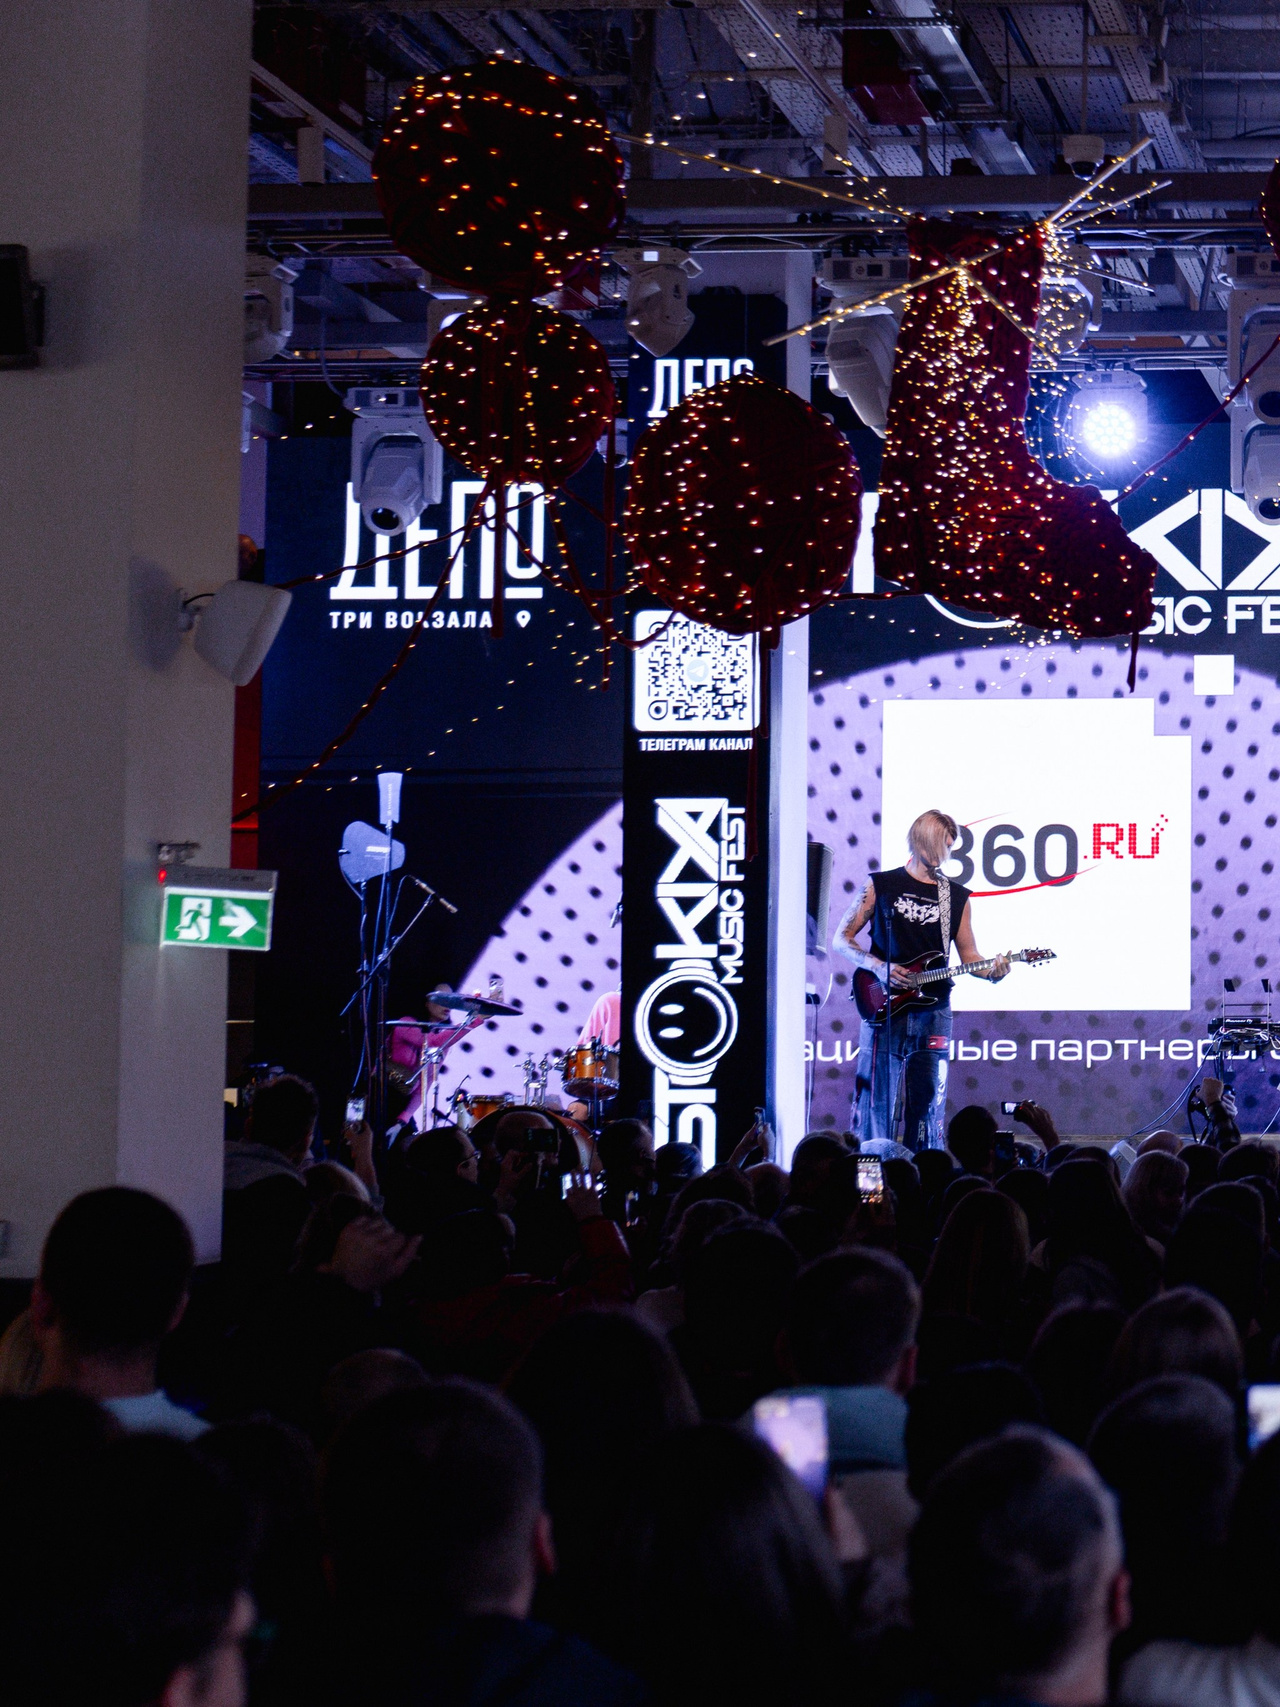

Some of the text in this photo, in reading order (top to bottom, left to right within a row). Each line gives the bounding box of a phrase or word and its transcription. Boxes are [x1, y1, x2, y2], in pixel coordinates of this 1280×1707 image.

[647, 358, 754, 418] ДЕ
[329, 611, 373, 629] ТРИ
[1138, 595, 1212, 635] SIC
[638, 737, 754, 751] ТЕЛЕГРАМ КАНАЛ
[719, 806, 746, 984] MUSIC FEST
